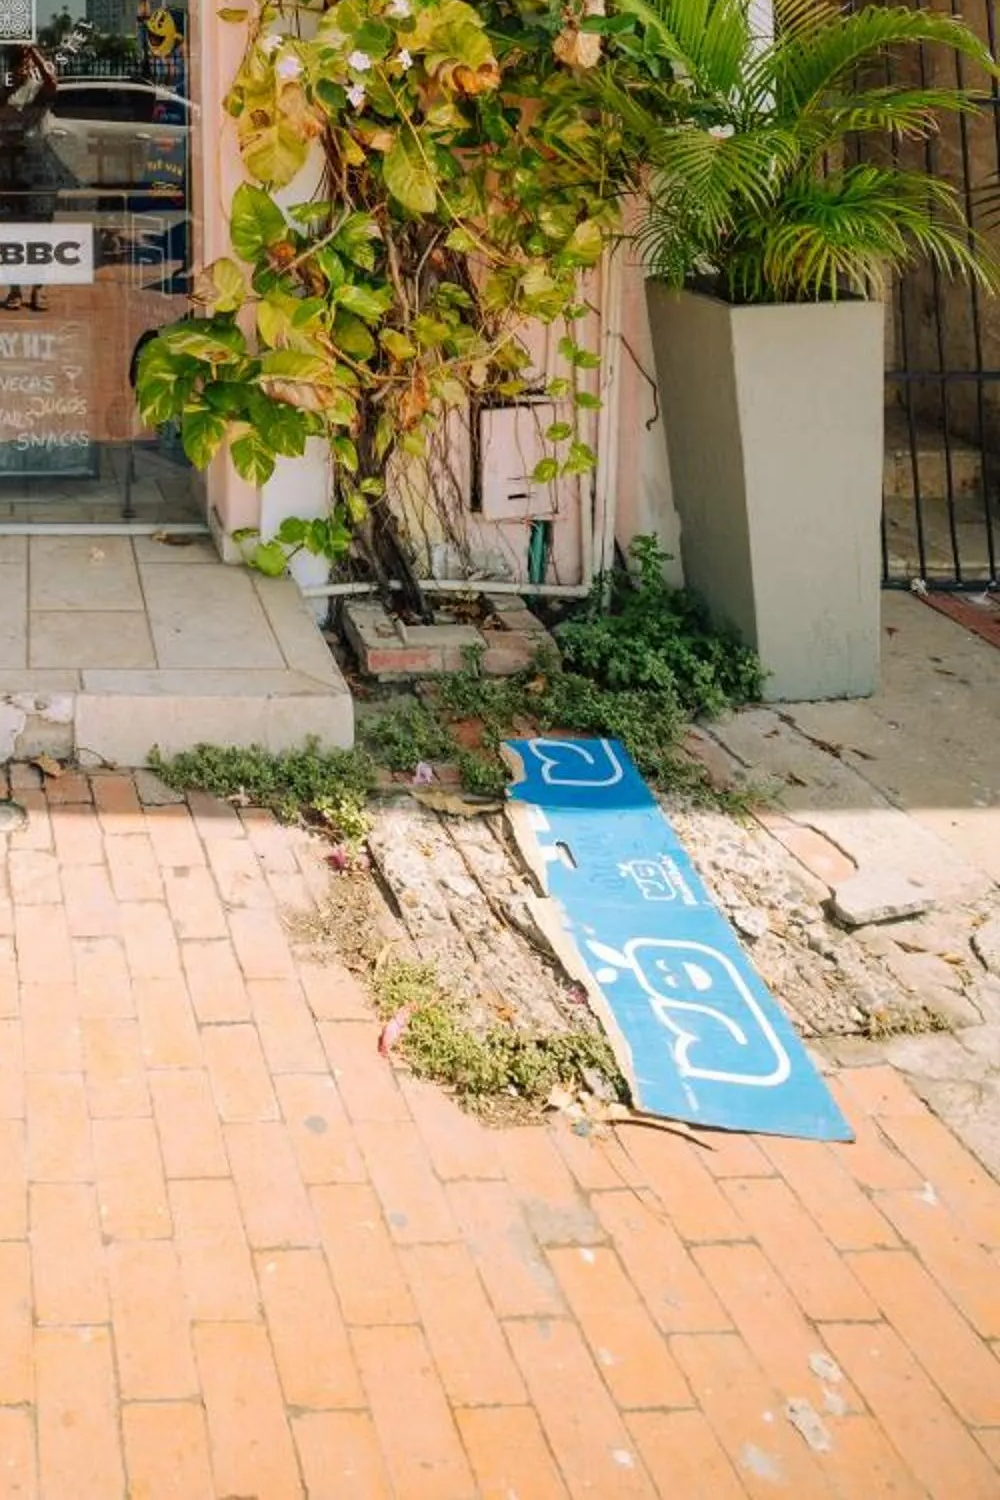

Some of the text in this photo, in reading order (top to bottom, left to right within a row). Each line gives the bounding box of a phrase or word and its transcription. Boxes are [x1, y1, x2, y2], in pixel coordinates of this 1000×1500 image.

[28, 19, 94, 82] HOSTEL
[25, 396, 88, 417] JUGOS
[14, 430, 90, 452] SNACKS
